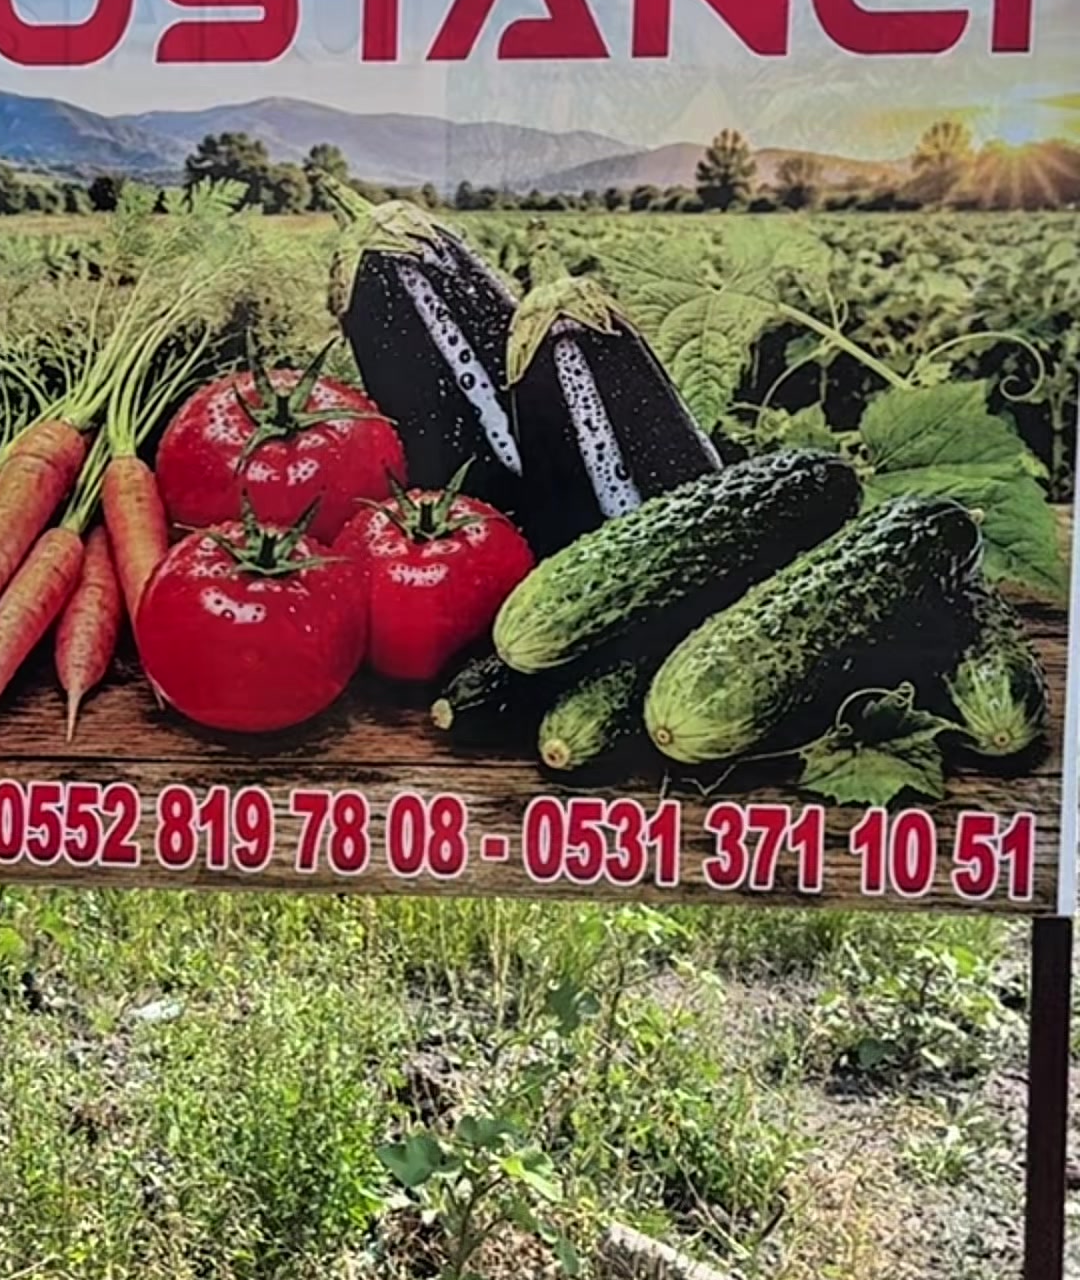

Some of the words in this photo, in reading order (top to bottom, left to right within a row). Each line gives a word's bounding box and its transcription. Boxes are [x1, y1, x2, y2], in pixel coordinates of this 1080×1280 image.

[156, 785, 274, 868] 819
[291, 790, 369, 873] 78
[386, 792, 467, 876] 08
[524, 797, 680, 884] 0531
[704, 803, 824, 888] 371
[848, 809, 935, 895] 10
[953, 813, 1034, 896] 51
